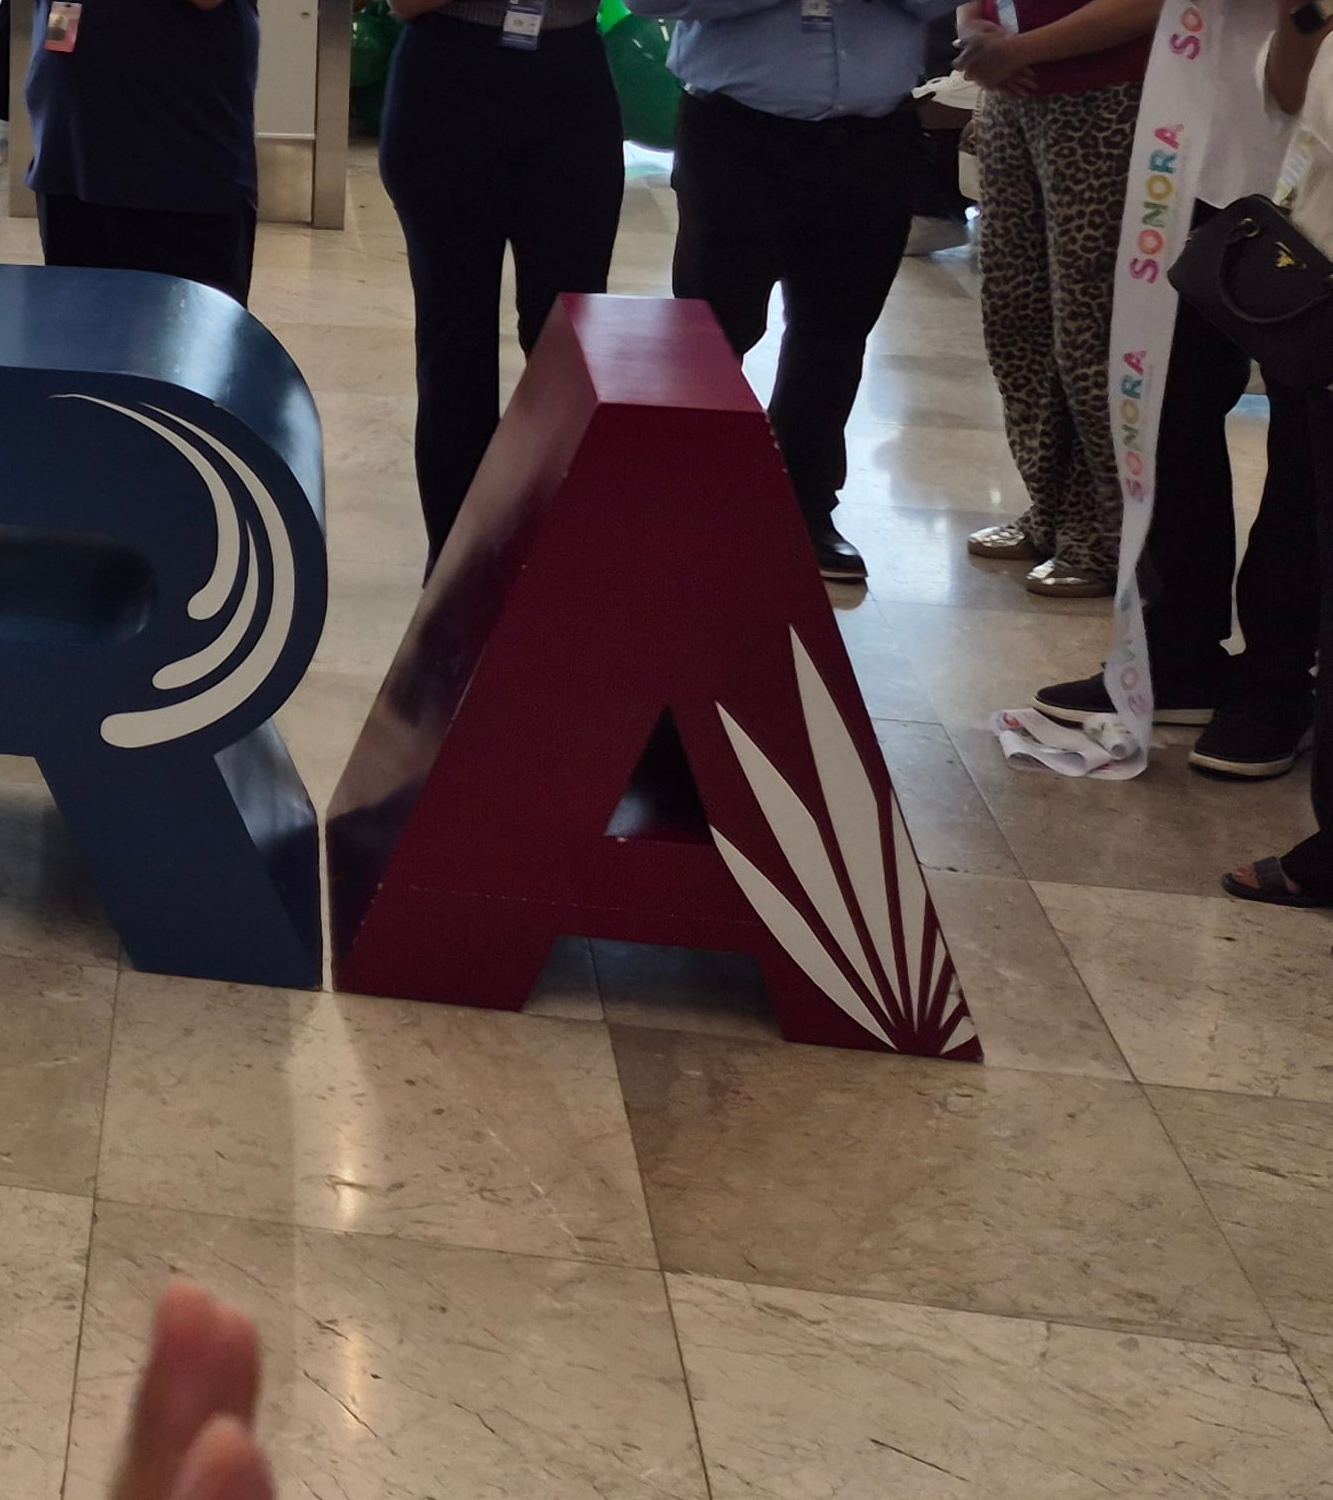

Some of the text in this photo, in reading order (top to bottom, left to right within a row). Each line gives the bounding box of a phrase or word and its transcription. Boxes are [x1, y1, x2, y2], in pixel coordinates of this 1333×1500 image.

[1170, 5, 1205, 61] SO
[1130, 123, 1184, 284] SONORA
[1121, 350, 1147, 503] SONORA
